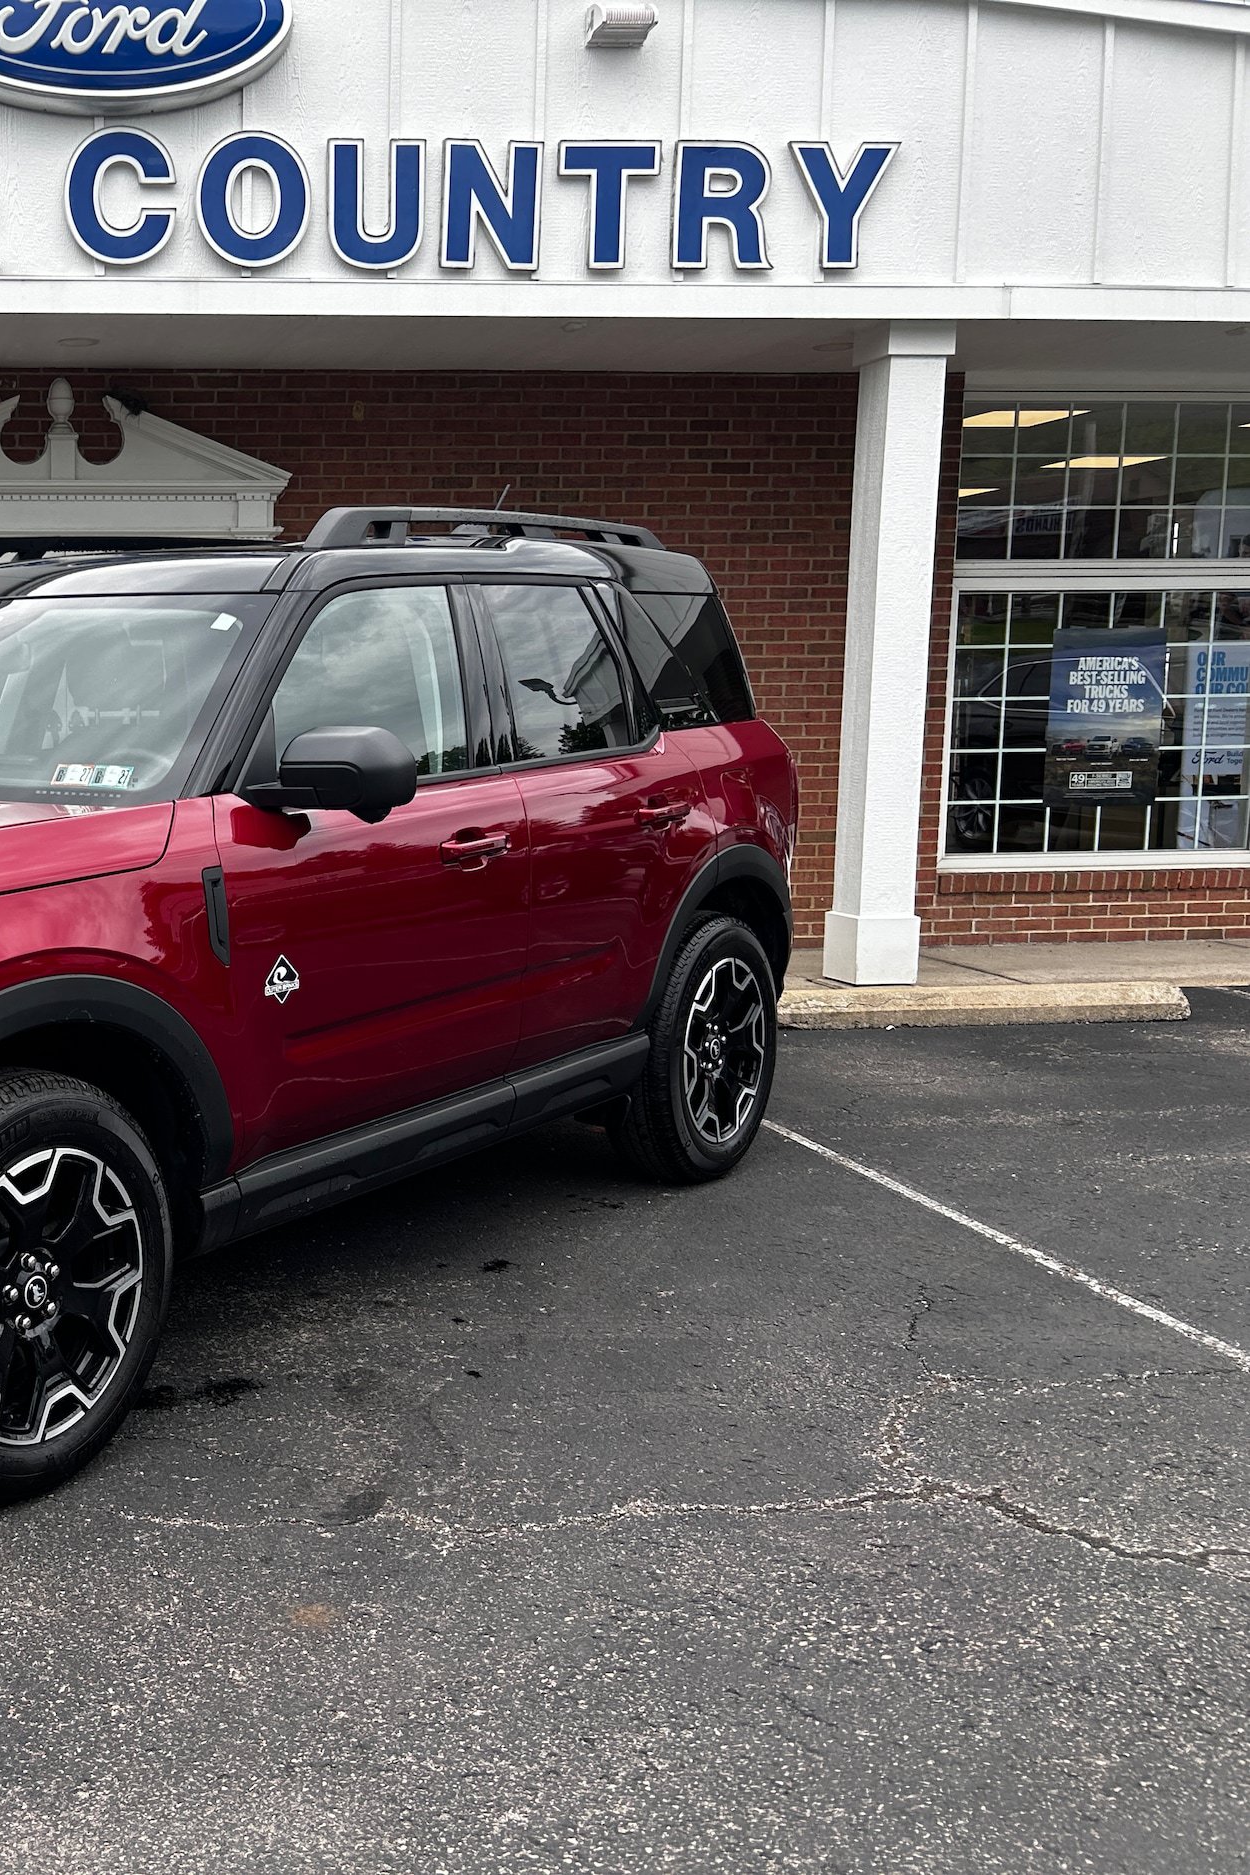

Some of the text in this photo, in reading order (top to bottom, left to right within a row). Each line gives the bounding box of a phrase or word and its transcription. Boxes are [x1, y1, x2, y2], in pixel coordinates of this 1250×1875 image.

[64, 125, 902, 271] COUNTRY
[1078, 656, 1140, 671] AMERICA'S
[1069, 671, 1147, 685] BEST-SELLING
[1084, 685, 1129, 699] TRUCKS
[1067, 698, 1145, 713] FOR 49 YEARS
[1072, 774, 1084, 784] 49
